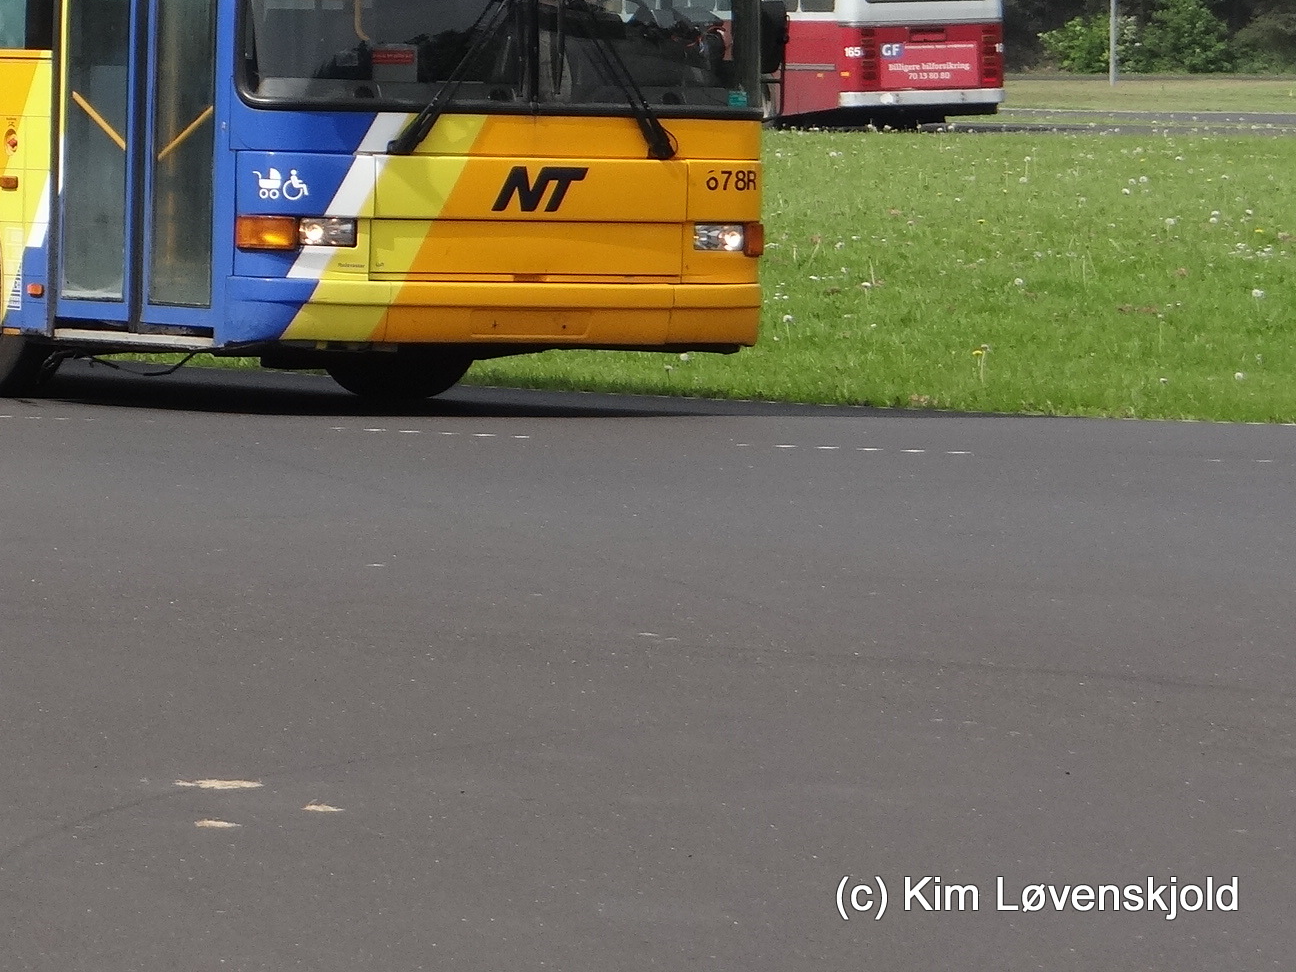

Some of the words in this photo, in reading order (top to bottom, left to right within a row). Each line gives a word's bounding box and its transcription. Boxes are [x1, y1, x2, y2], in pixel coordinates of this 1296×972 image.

[881, 44, 901, 56] GF
[888, 63, 920, 72] Billigere
[921, 62, 970, 71] bilforsikring
[908, 72, 918, 80] 70
[491, 166, 589, 212] NT
